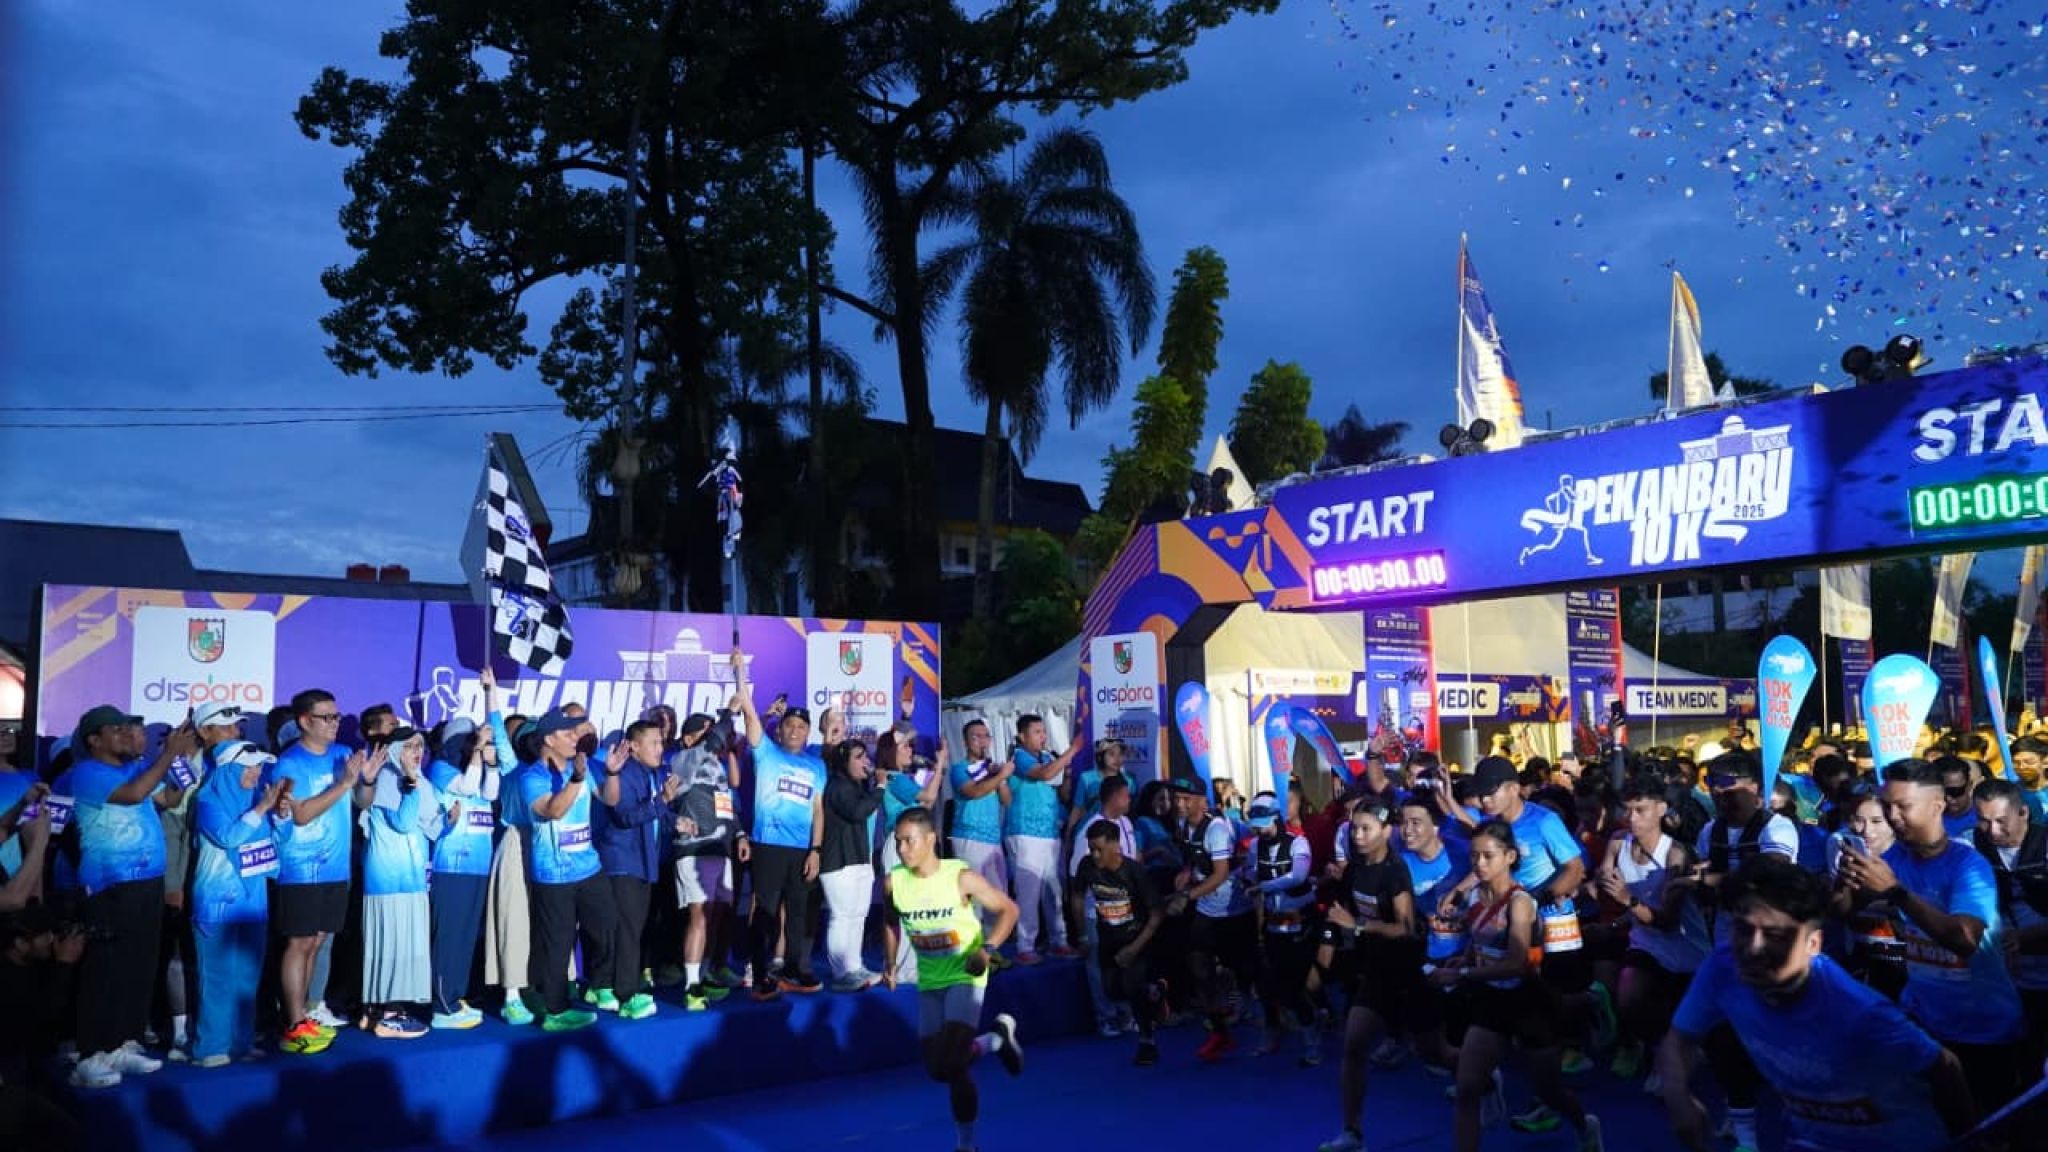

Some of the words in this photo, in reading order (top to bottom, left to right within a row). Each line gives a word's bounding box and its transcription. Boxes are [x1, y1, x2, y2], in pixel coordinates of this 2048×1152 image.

[1573, 447, 1793, 526] PEKANBARU
[1306, 490, 1434, 547] START
[1734, 503, 1765, 518] 2025
[1314, 553, 1446, 597] 00:00:00.00
[144, 675, 263, 706] dispora
[814, 685, 887, 709] dipora
[1637, 690, 1674, 709] TEAM
[1678, 691, 1718, 709] MEDIC
